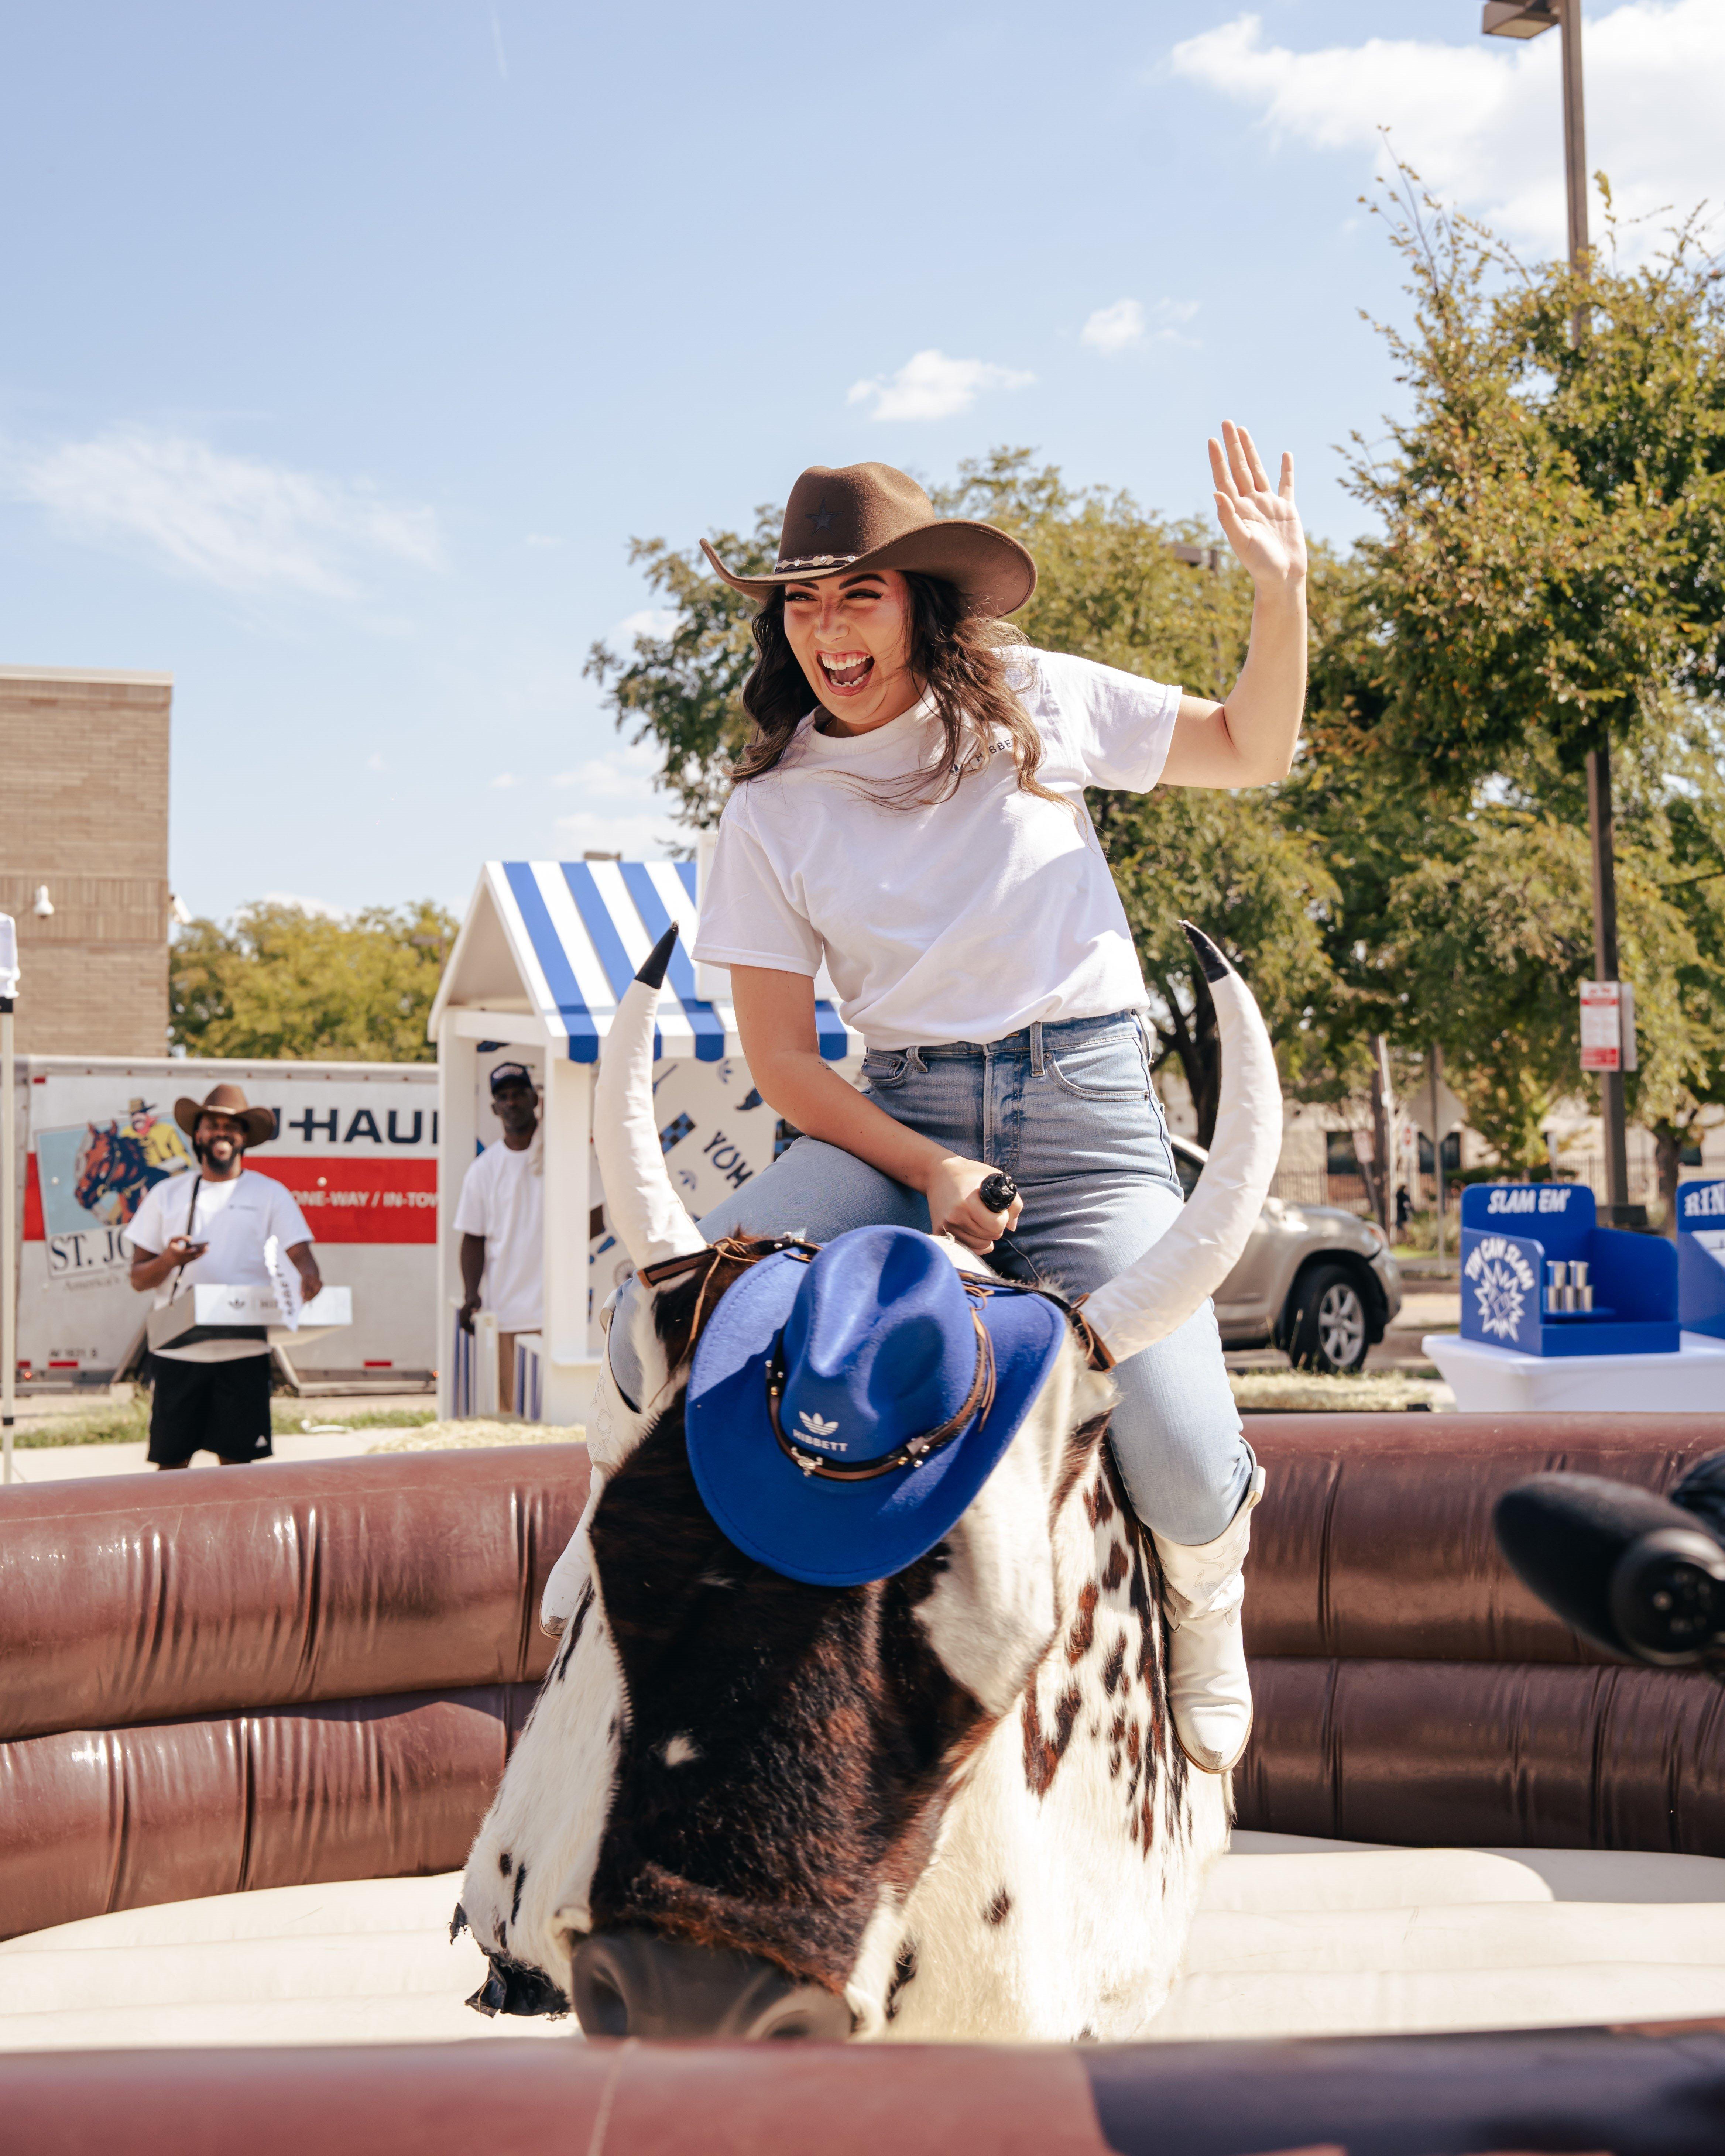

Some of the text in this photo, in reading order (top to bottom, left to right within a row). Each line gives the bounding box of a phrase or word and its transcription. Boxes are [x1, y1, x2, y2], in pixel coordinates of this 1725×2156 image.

[1487, 1189, 1537, 1214] SLAM
[51, 1232, 93, 1271] ST.
[1480, 1237, 1508, 1263] CAN
[1503, 1243, 1536, 1291] SLAM
[793, 1428, 848, 1452] HIBBETT
